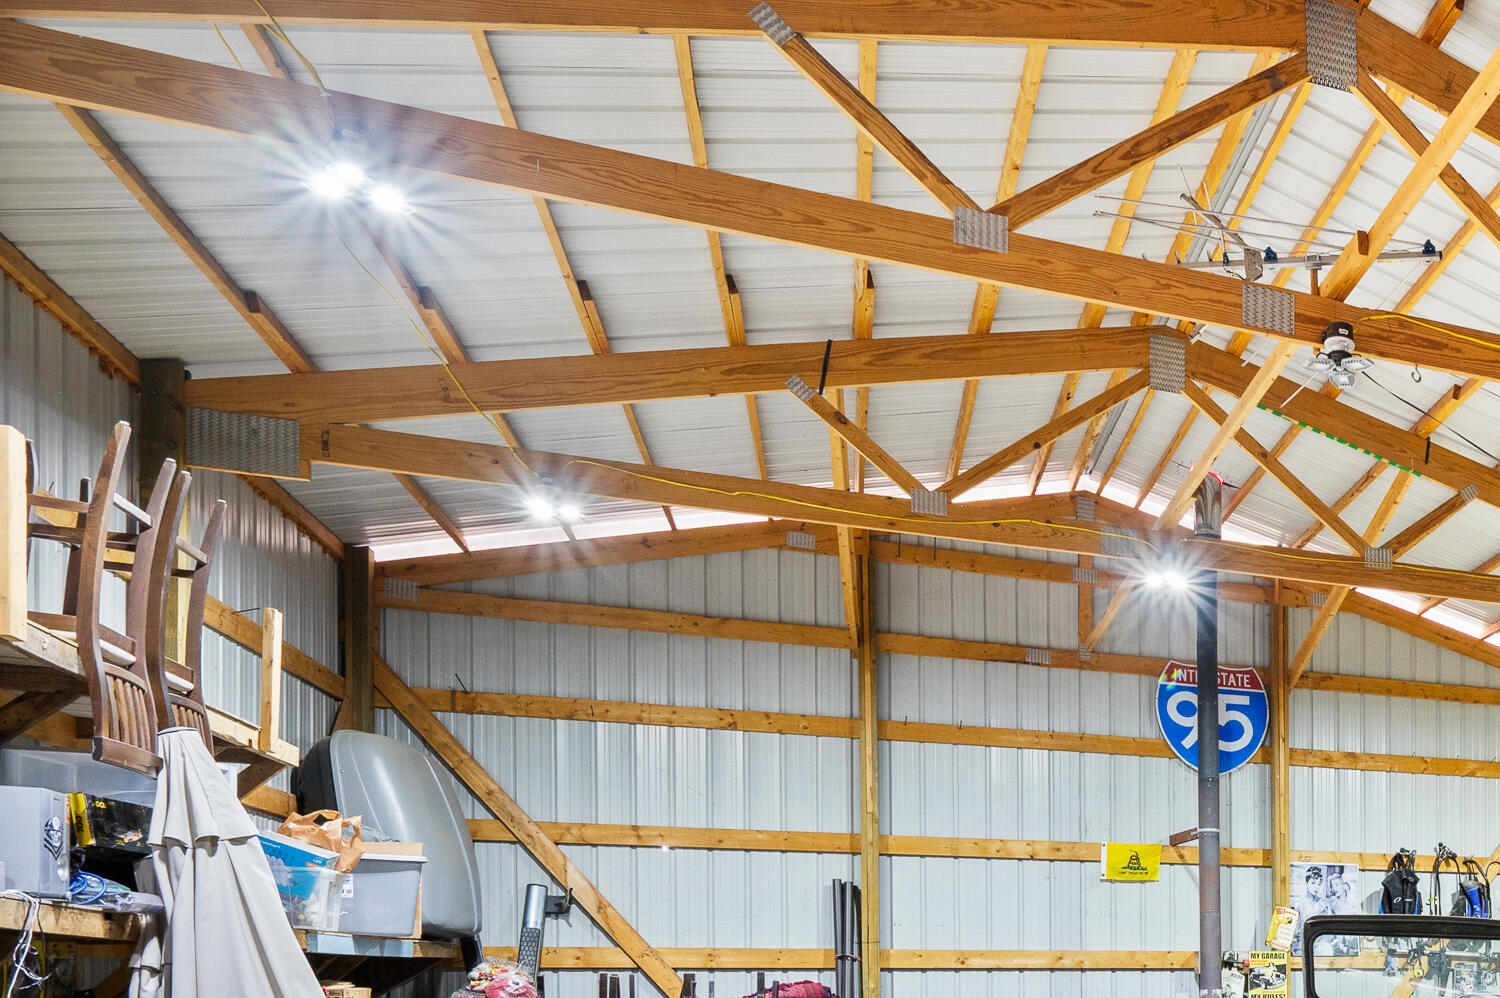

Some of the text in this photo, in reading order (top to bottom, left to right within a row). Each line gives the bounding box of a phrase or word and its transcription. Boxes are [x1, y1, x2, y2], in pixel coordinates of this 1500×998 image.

[1173, 668, 1251, 688] INTTATE
[1166, 690, 1254, 752] 95
[1250, 952, 1286, 960] MY GARAGE
